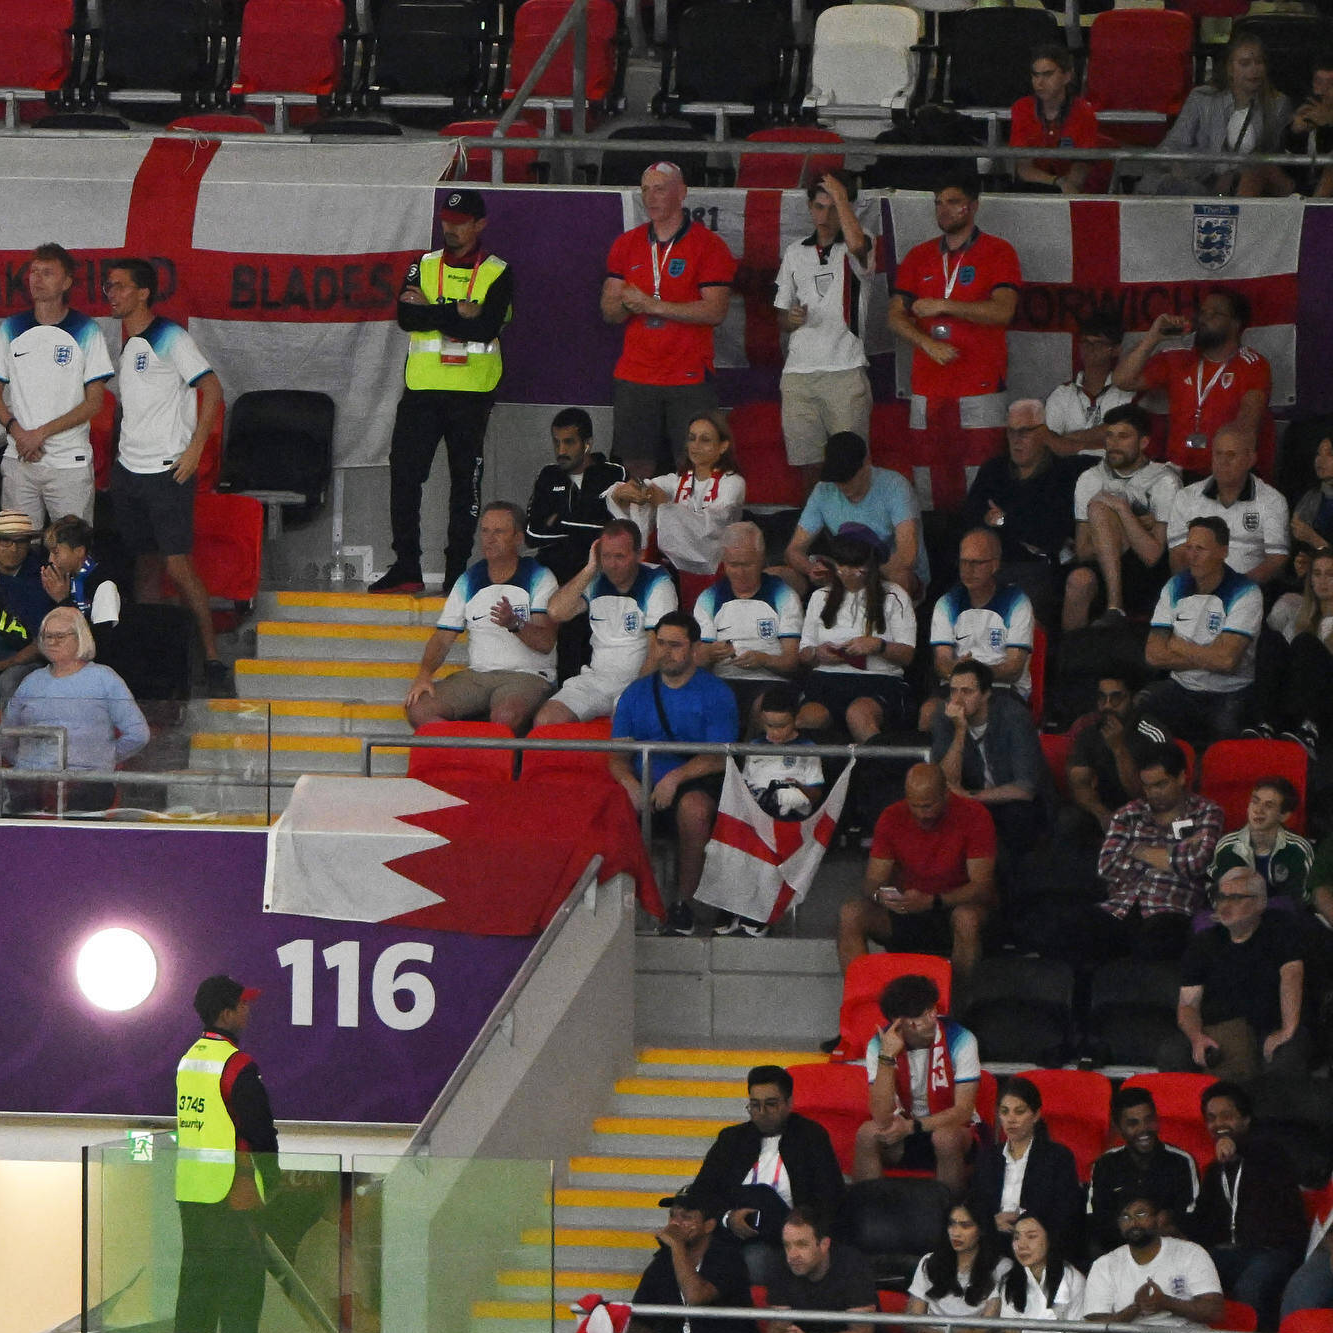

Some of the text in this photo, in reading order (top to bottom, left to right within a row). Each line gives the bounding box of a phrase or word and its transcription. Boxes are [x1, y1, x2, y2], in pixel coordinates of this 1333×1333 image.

[229, 263, 393, 310] BLADES
[1023, 284, 1200, 326] ORWICH
[276, 939, 435, 1031] 116
[179, 1095, 205, 1113] 3745
[180, 1118, 204, 1131] ecurity
